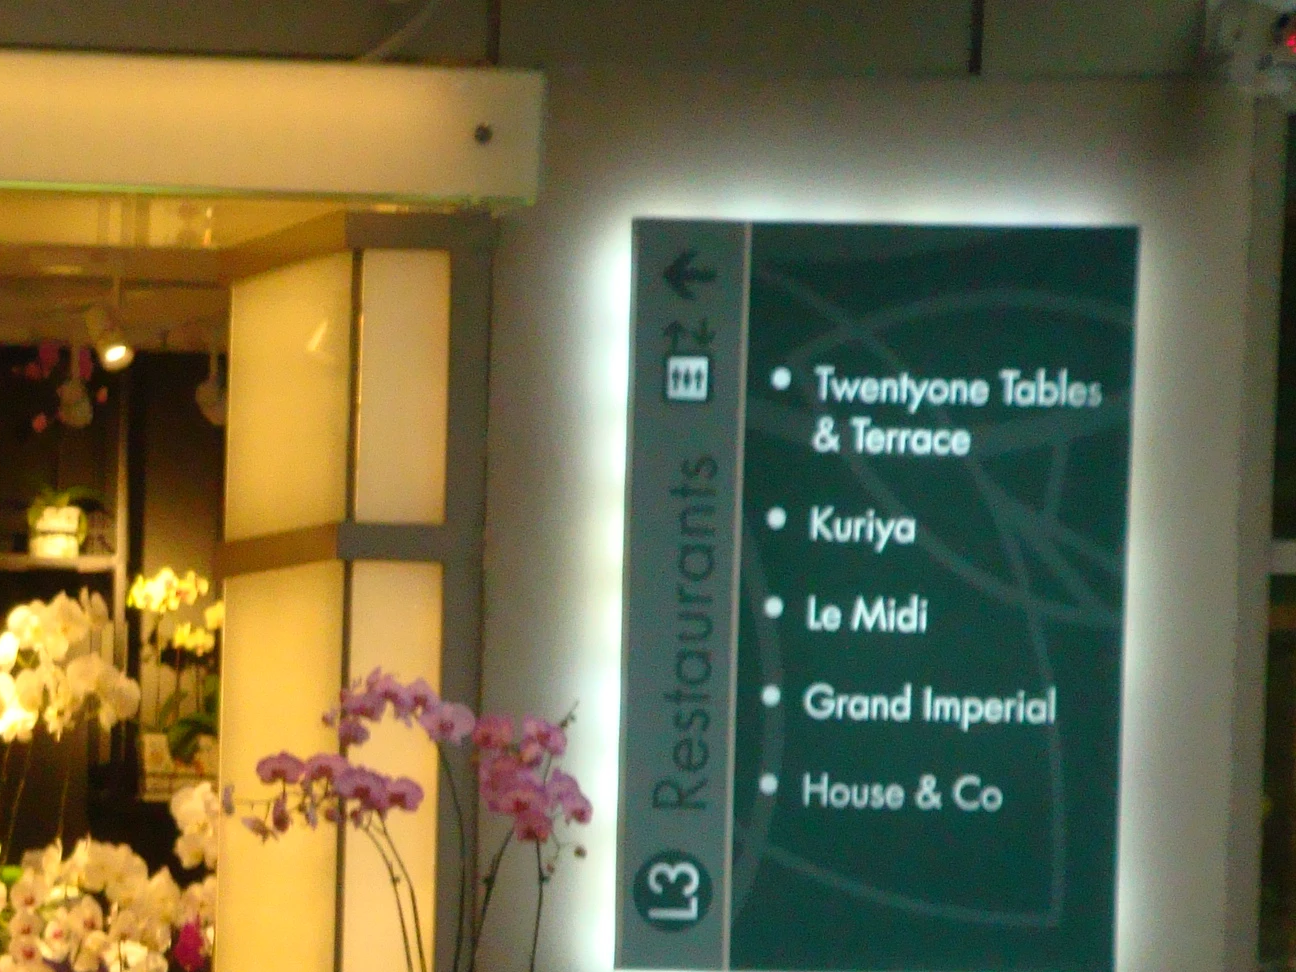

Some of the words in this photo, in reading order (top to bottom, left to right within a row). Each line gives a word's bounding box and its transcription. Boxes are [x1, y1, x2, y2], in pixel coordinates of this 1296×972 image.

[814, 365, 990, 414] Twentyone
[1000, 368, 1104, 408] Tables
[812, 417, 840, 453] &
[851, 416, 971, 456] Terrace
[810, 506, 917, 553] Kuriya
[652, 453, 719, 812] Restaurants
[807, 594, 842, 632] Le
[852, 594, 928, 633] Midi
[804, 682, 913, 722] Grand
[923, 685, 1057, 732] Imperial
[804, 773, 904, 810] House
[915, 775, 942, 810] &
[953, 775, 1004, 812] Co
[648, 860, 700, 921] L3
